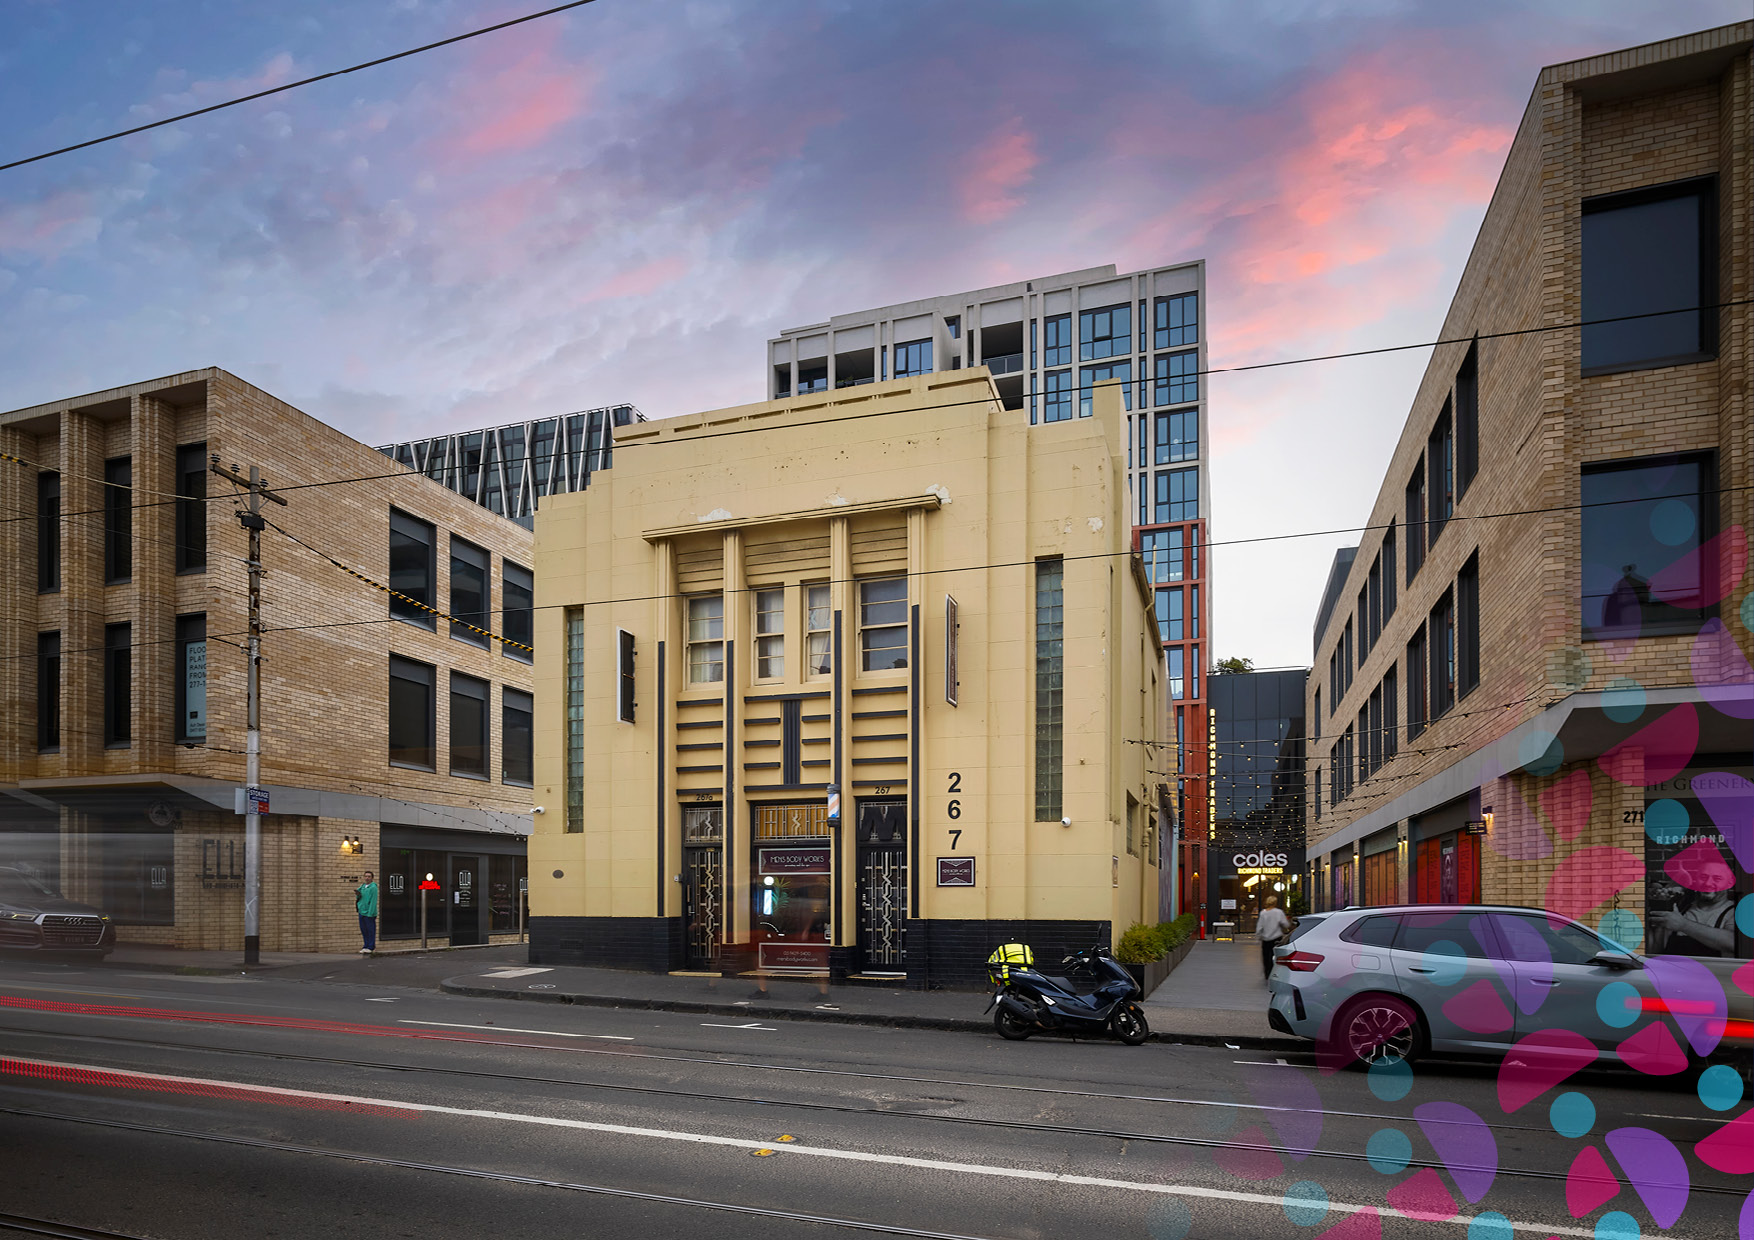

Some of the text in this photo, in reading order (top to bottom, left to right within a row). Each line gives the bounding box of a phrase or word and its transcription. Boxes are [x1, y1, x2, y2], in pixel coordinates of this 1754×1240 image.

[875, 786, 891, 794] 267
[1646, 780, 1668, 791] HE
[696, 793, 713, 801] 267a
[947, 772, 962, 850] 267
[1623, 811, 1644, 824] 271
[1656, 834, 1726, 845] RICHMOND
[202, 839, 246, 880] ELL
[803, 855, 825, 863] WORKS
[1232, 849, 1289, 867] coles
